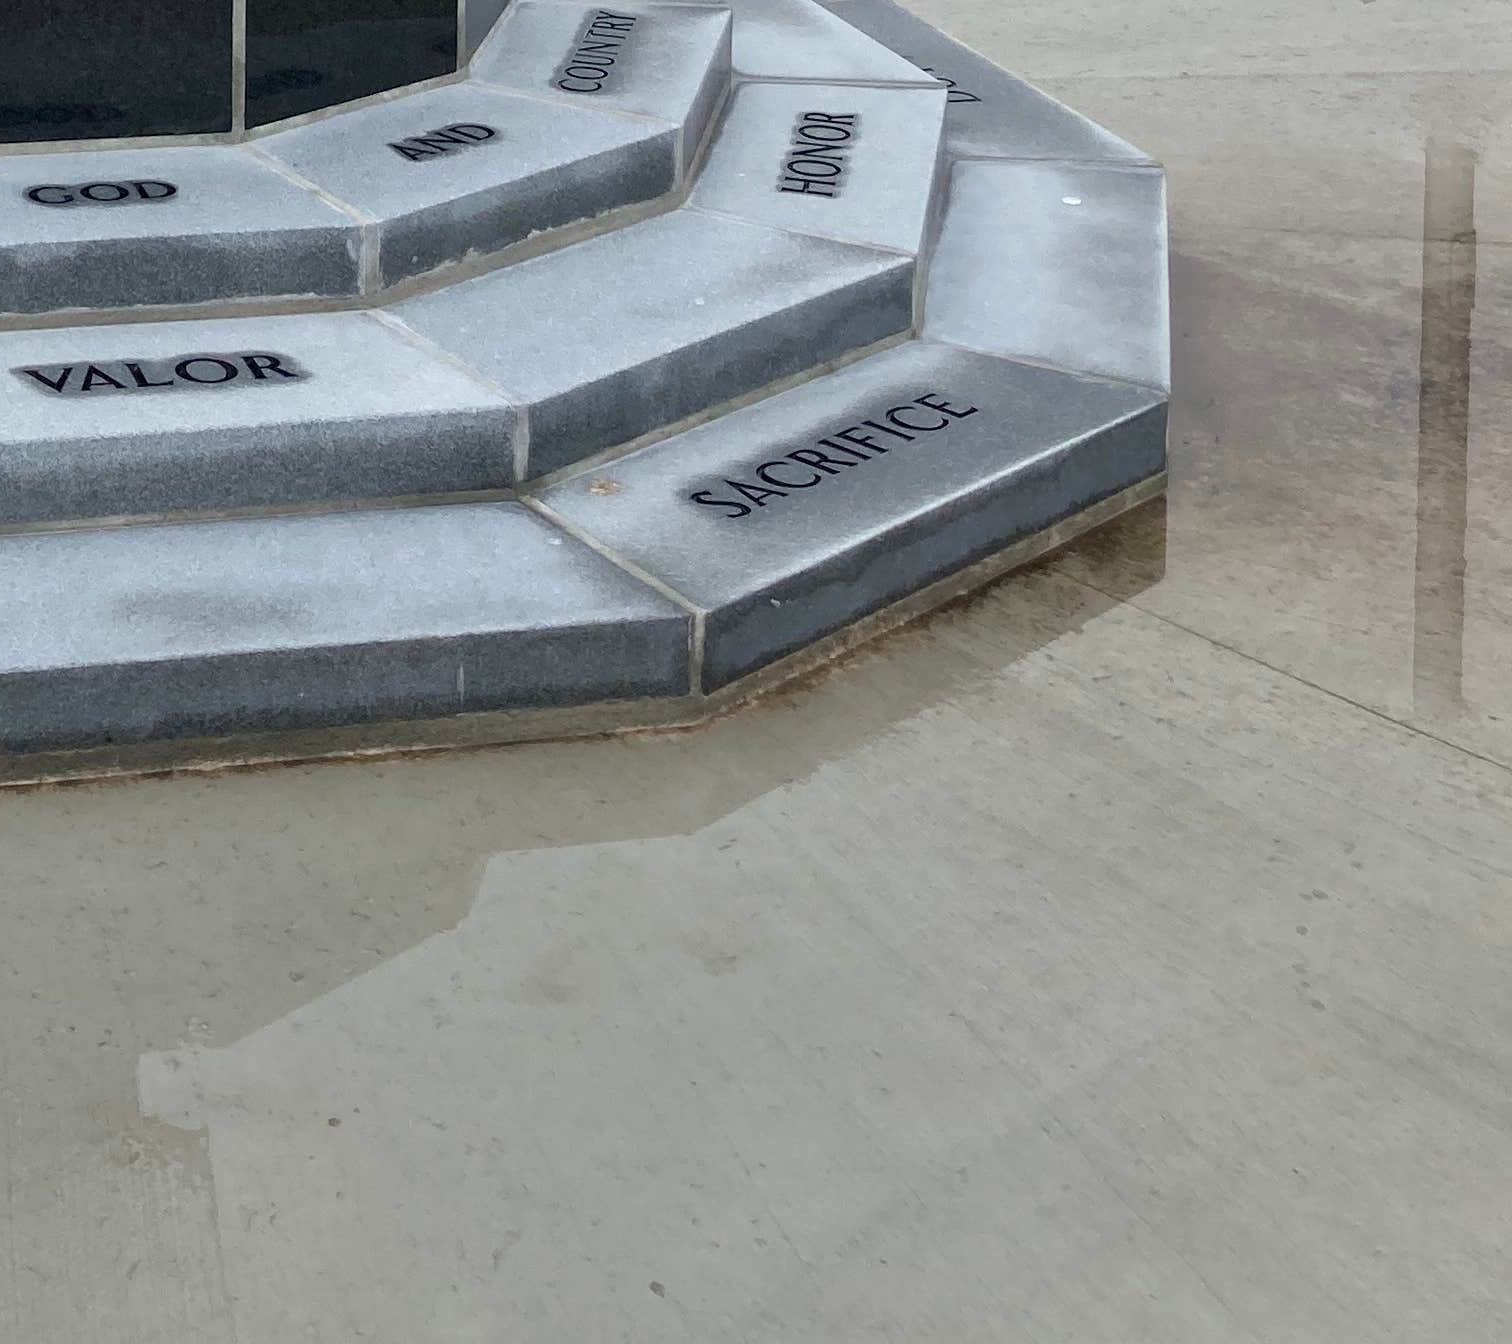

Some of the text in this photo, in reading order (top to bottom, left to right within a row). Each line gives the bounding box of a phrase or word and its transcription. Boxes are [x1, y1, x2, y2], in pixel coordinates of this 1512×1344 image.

[558, 10, 637, 93] COUNTRY
[387, 124, 496, 162] AND
[780, 112, 855, 197] HONOR
[27, 181, 177, 206] GOD
[22, 355, 299, 393] VALOR
[690, 393, 978, 519] SACRIFICE
